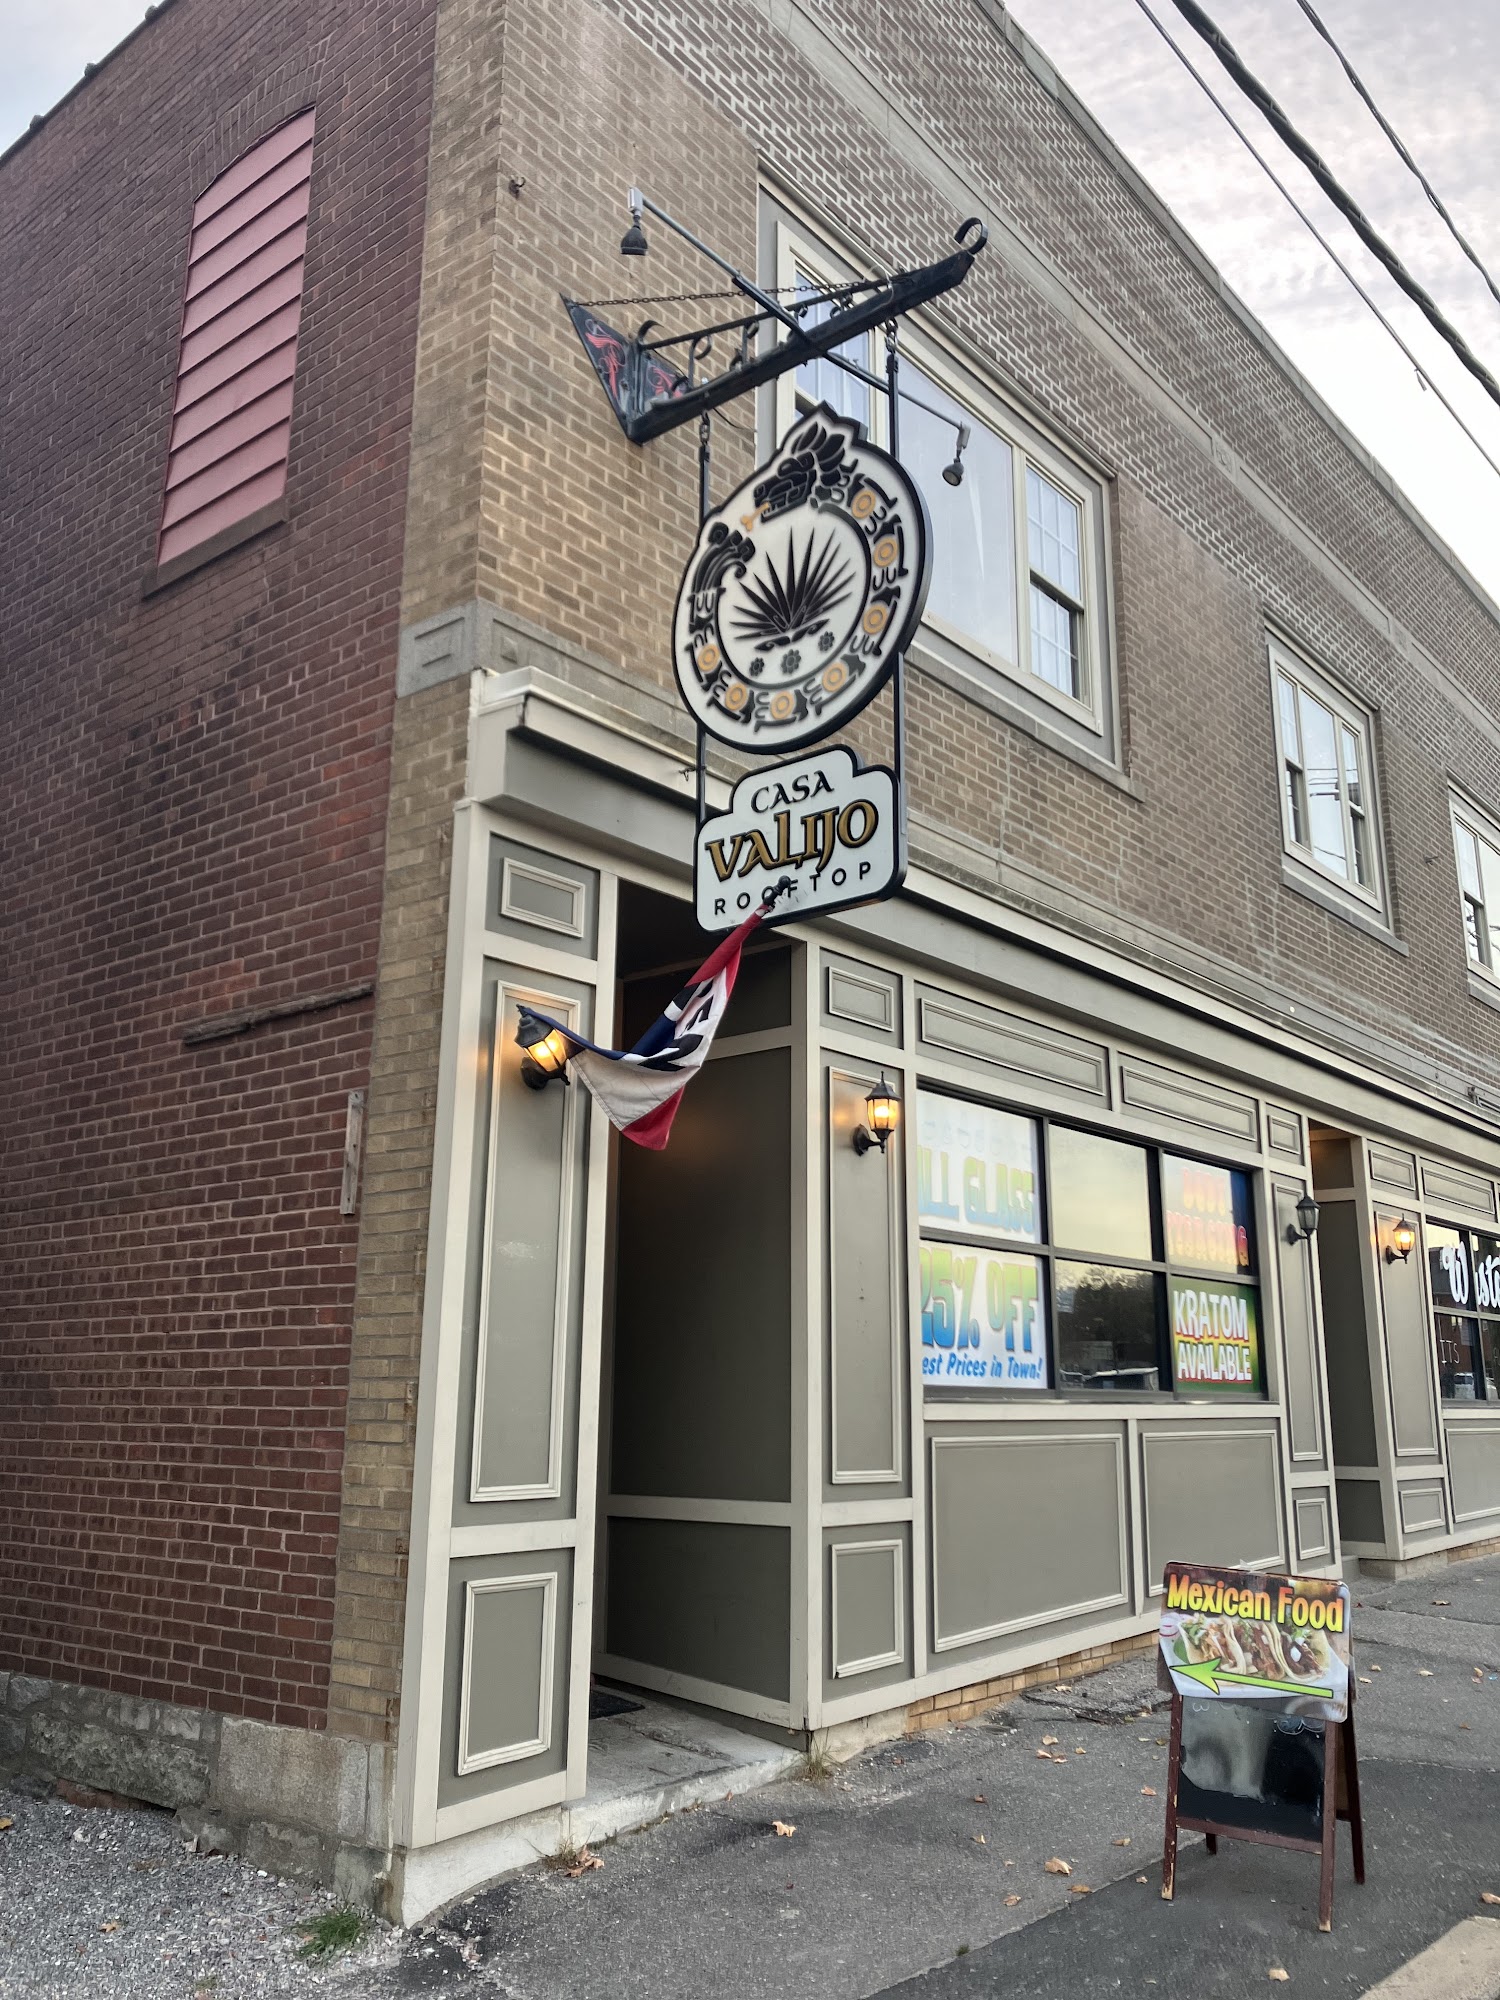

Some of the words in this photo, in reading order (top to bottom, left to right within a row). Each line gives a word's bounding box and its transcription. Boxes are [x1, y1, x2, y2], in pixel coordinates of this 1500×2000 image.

[751, 770, 834, 813] CASA
[704, 799, 879, 882] VALIJO
[714, 861, 871, 916] ROOFTOP
[986, 1260, 1038, 1352] OFF
[1173, 1289, 1250, 1341] KRATOM
[922, 1353, 943, 1376] est
[947, 1352, 986, 1377] Prices
[990, 1355, 1003, 1377] in
[1008, 1356, 1042, 1379] Town!
[1177, 1340, 1253, 1383] AVAILABLE
[1167, 1573, 1271, 1621] Mexican
[1277, 1586, 1345, 1633] Food
